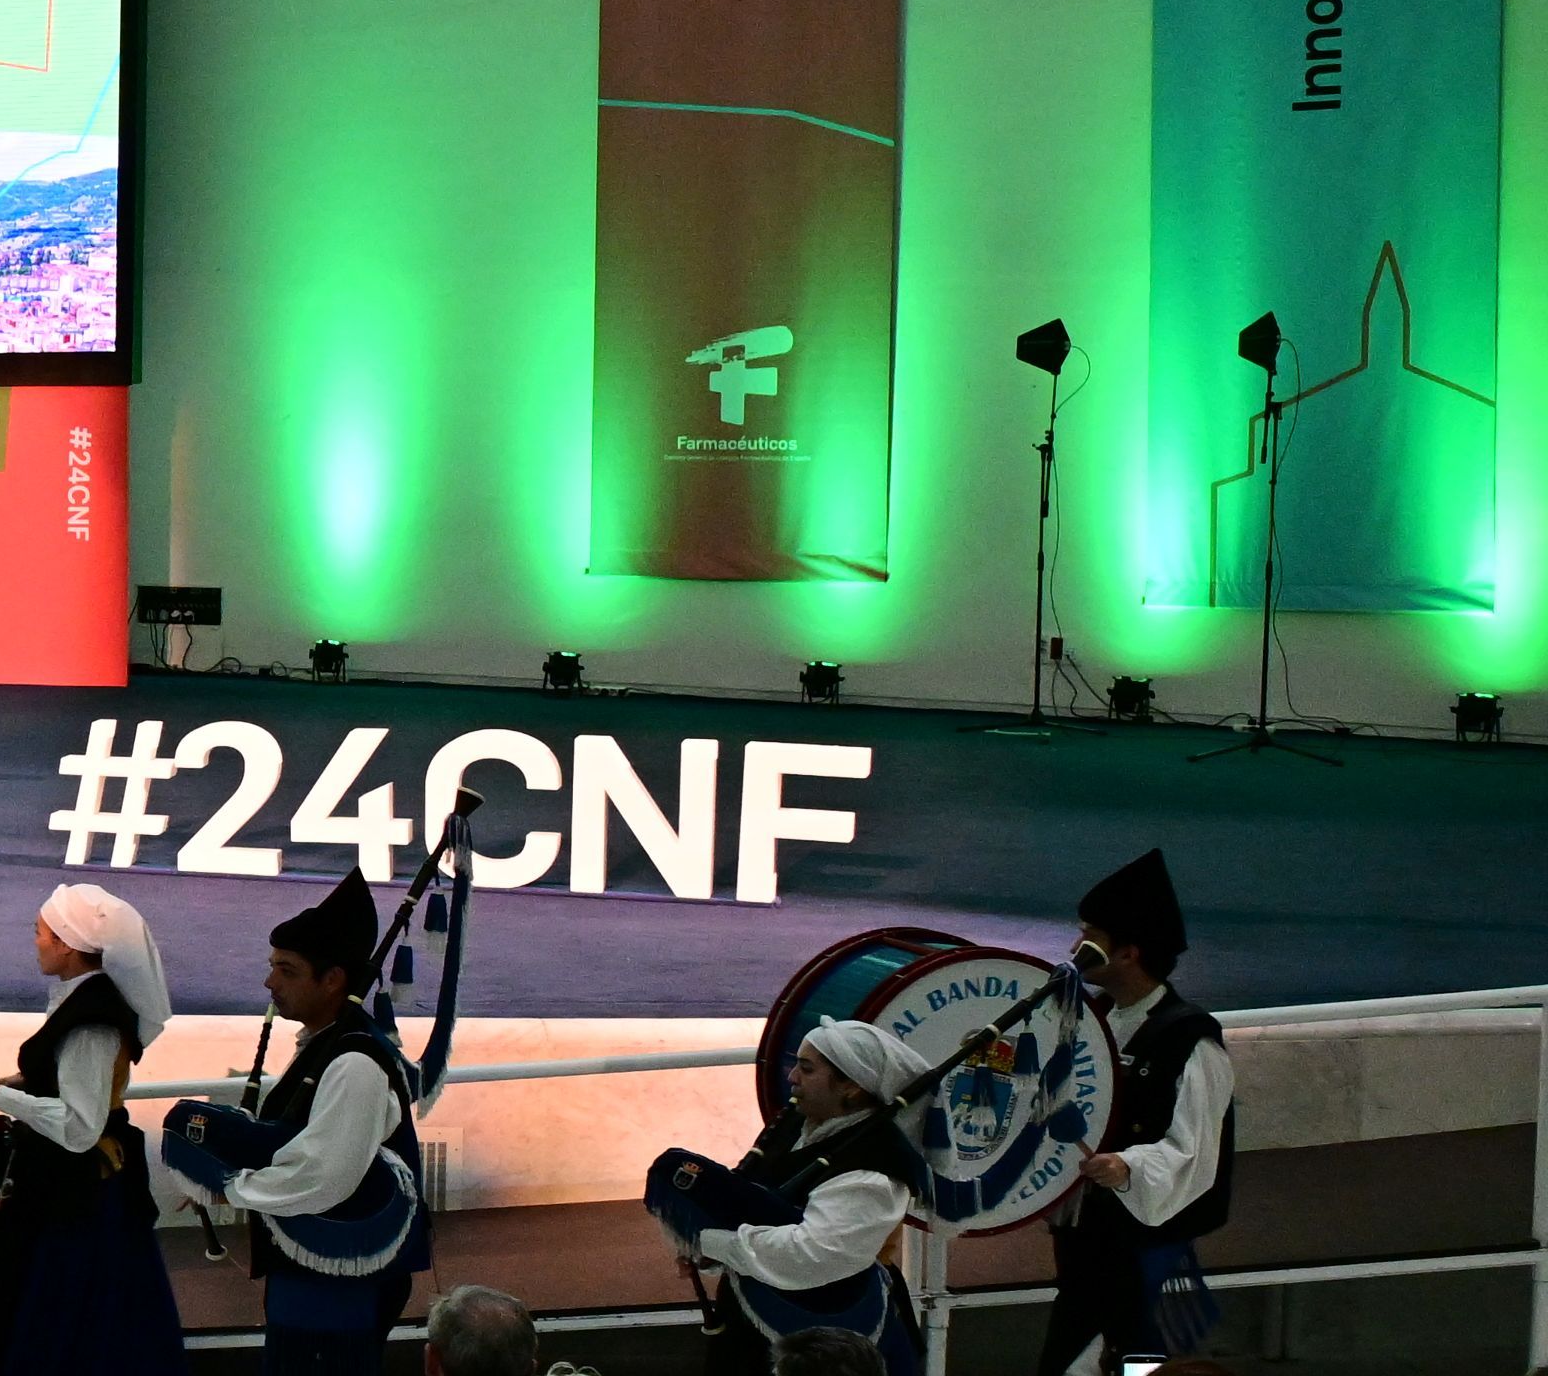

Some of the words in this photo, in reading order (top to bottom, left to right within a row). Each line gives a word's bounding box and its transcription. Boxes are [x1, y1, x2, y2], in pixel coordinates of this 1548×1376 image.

[67, 426, 92, 542] #24CNF
[677, 435, 798, 451] Farmacéuticos
[48, 718, 873, 905] #24CNF
[926, 976, 1020, 1013] BANDA
[1071, 1037, 1098, 1116] AITAS
